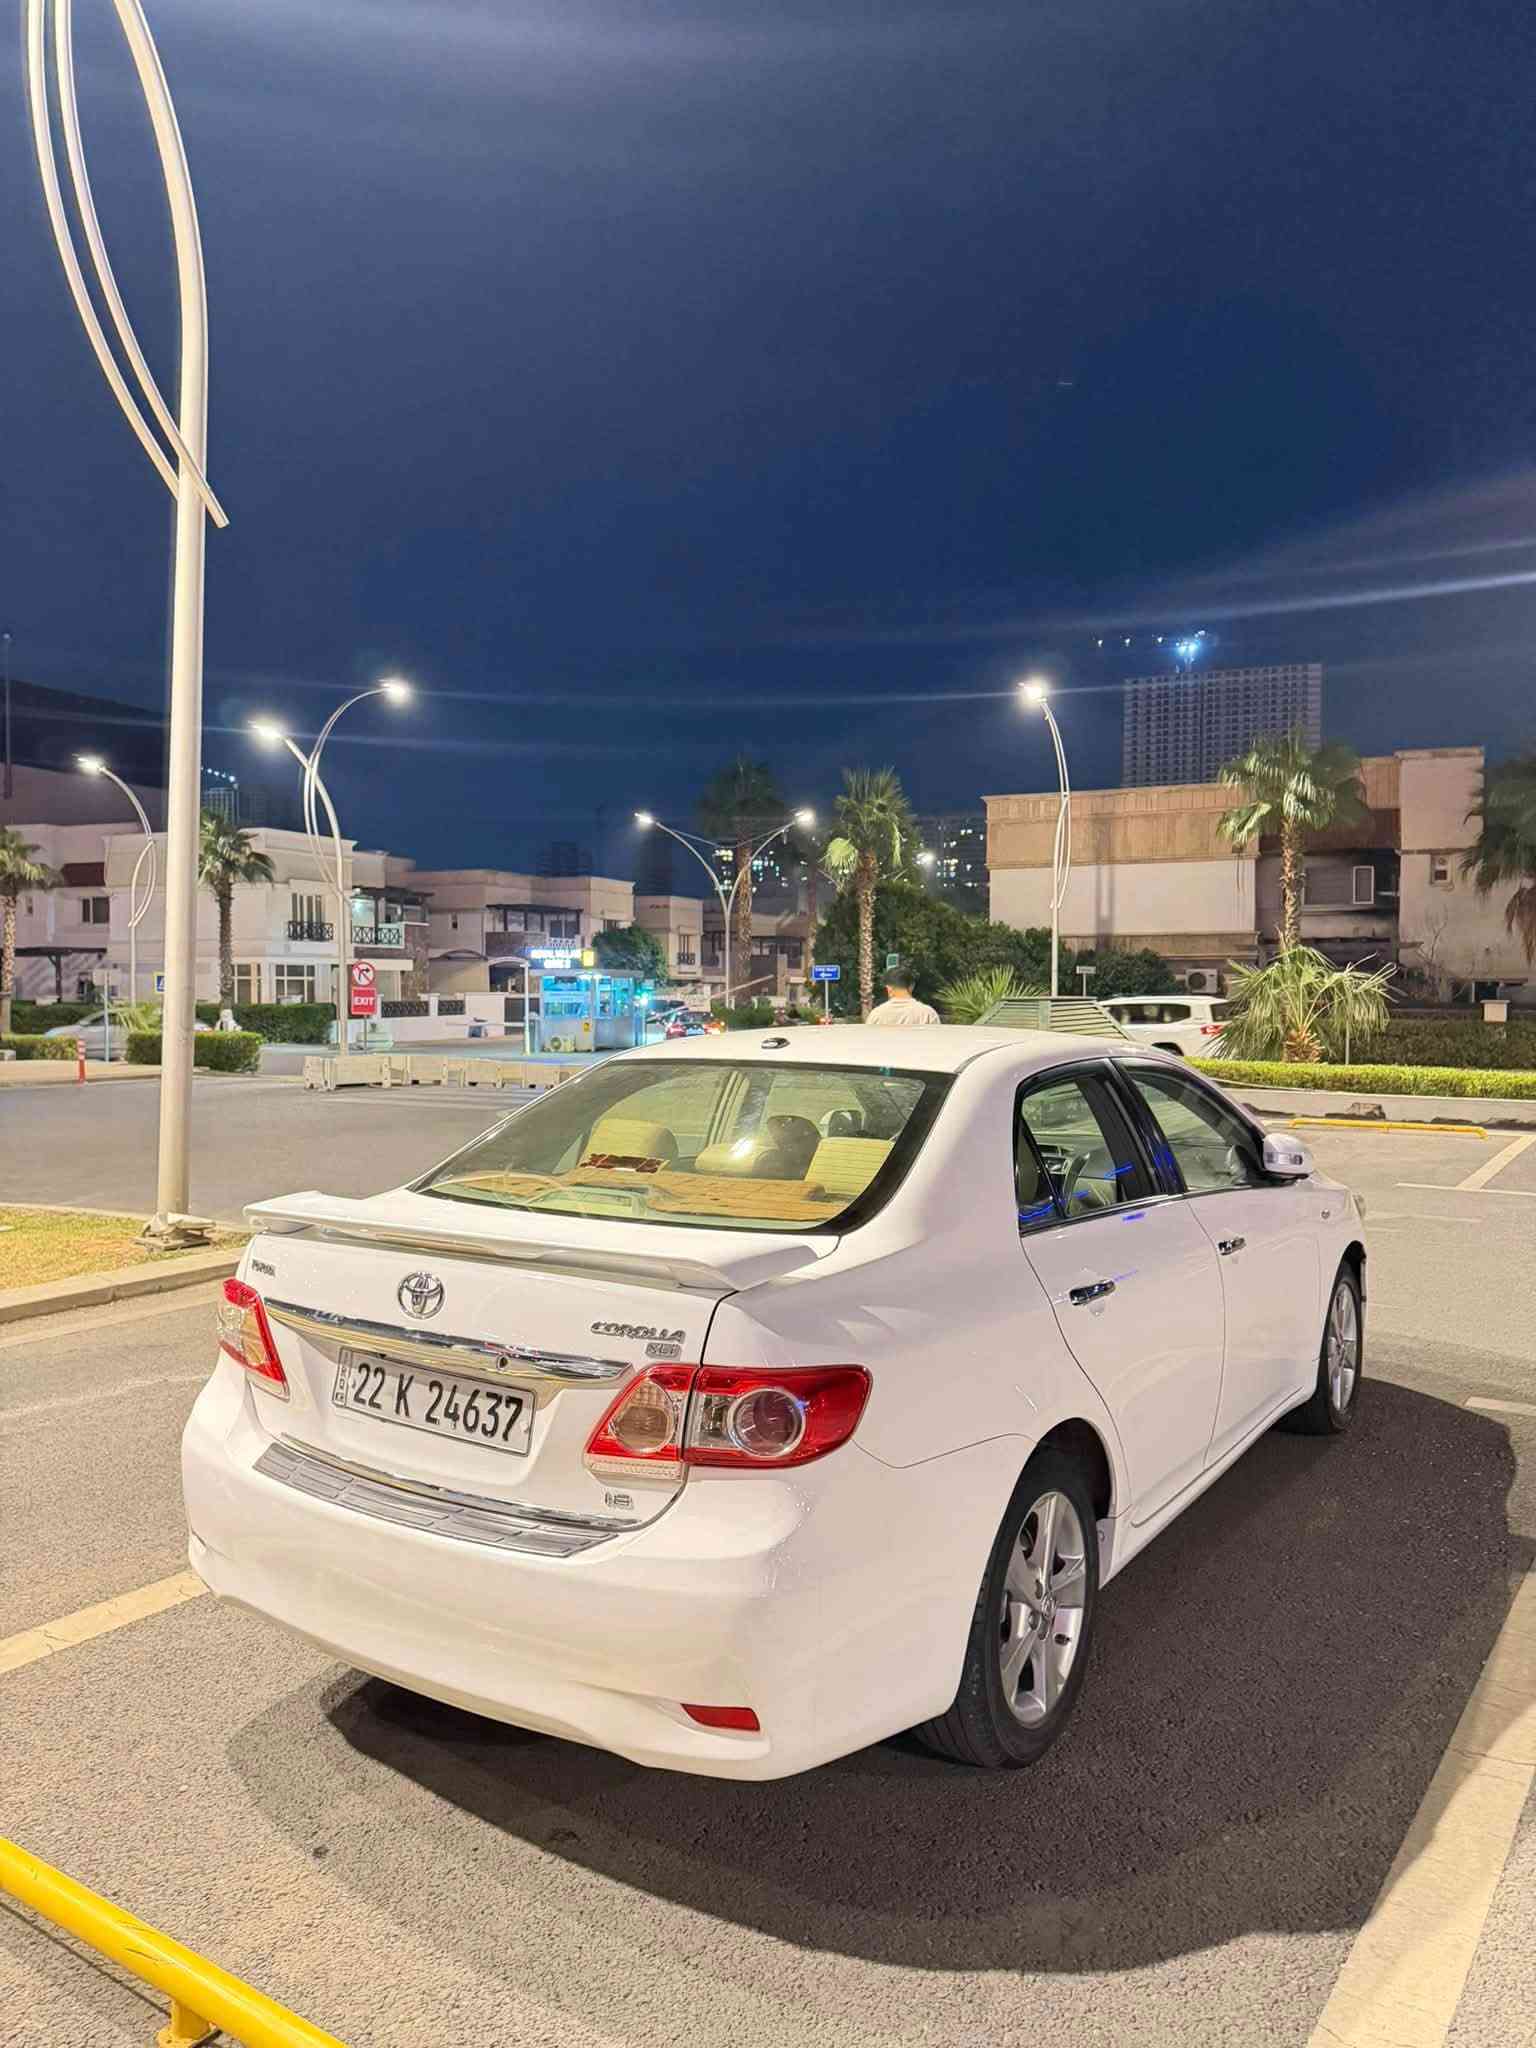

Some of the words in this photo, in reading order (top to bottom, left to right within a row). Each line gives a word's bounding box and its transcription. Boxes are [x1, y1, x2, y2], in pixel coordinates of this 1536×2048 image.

[354, 997, 376, 1006] EXIT
[353, 1363, 385, 1409] 22
[395, 1373, 415, 1417] K
[425, 1380, 523, 1441] 24637
